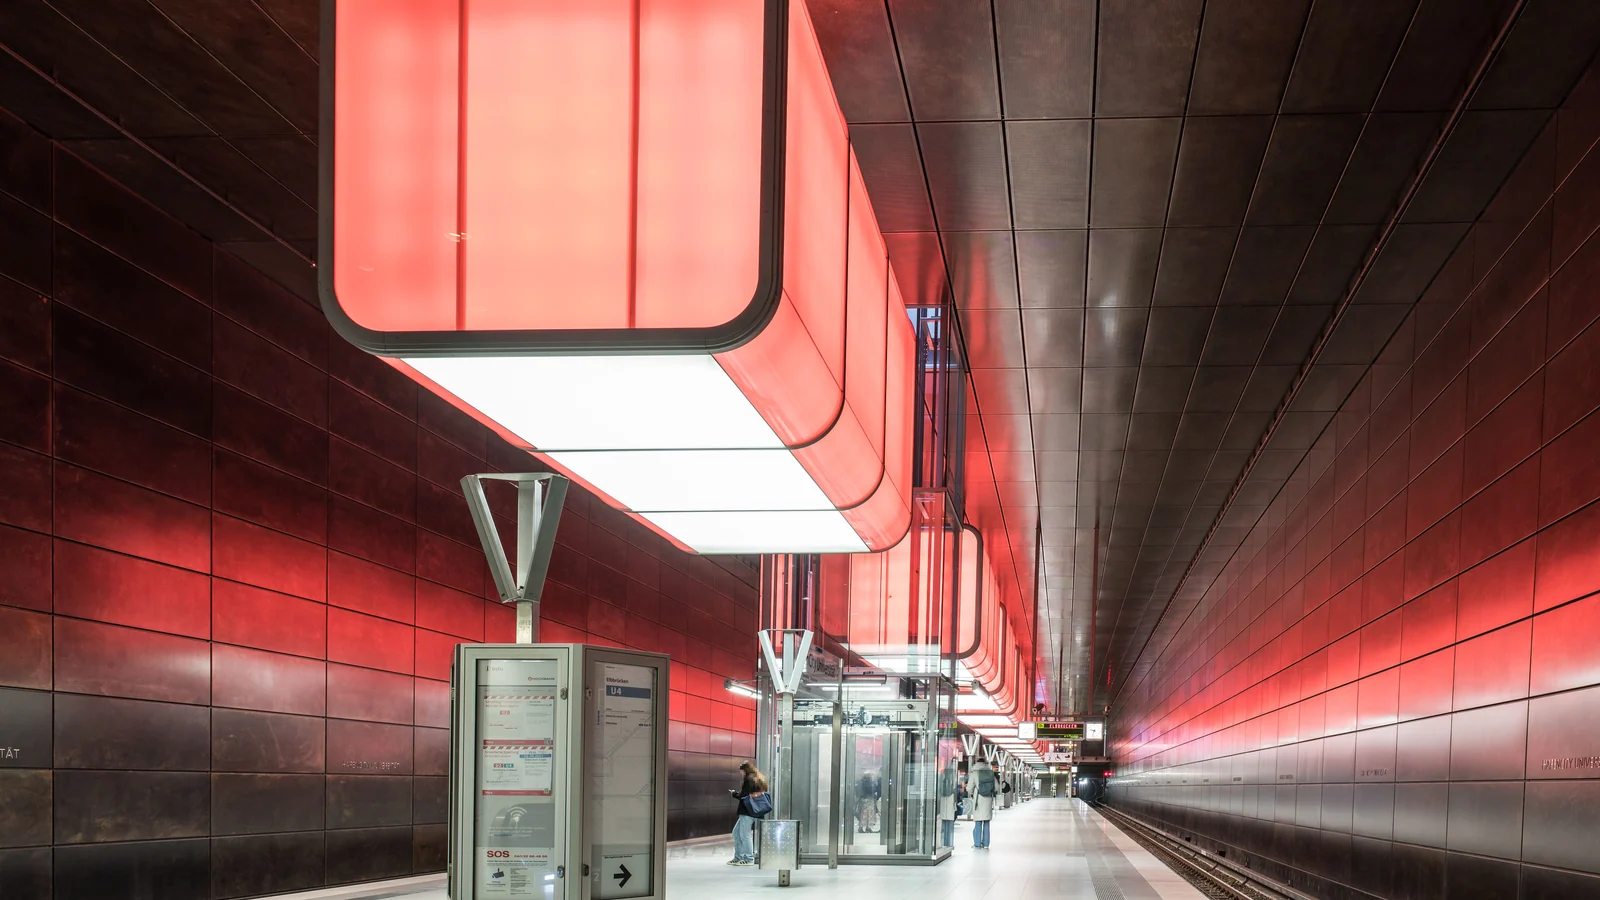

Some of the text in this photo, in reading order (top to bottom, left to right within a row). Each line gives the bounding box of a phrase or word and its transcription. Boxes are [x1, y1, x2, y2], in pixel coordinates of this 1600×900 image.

[610, 686, 622, 696] U4
[0, 746, 20, 759] TÄT
[486, 850, 510, 858] SOS
[593, 872, 600, 882] 2
